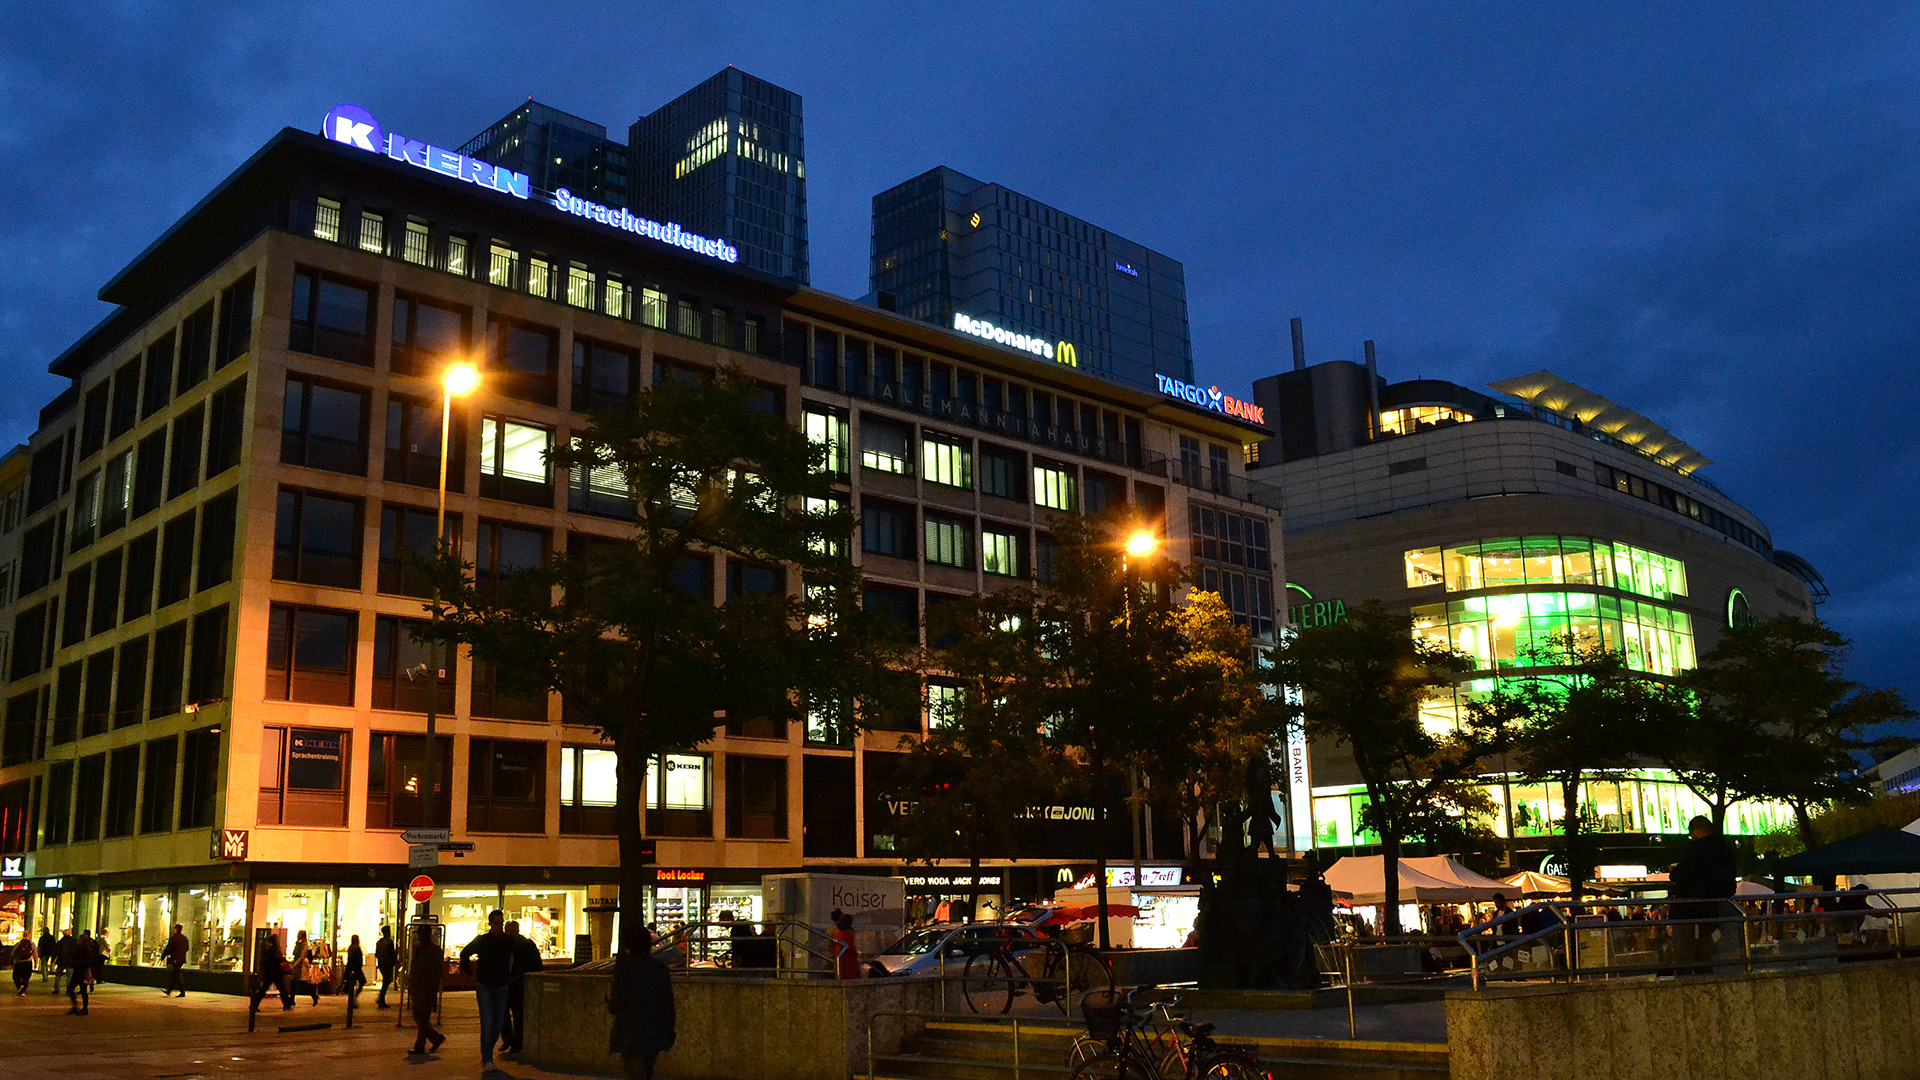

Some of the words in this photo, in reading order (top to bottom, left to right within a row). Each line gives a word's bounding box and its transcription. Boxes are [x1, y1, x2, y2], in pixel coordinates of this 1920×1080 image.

[388, 132, 530, 200] KERN
[555, 187, 738, 263] Sprachendienste
[953, 312, 1054, 359] McDonald's
[291, 752, 339, 762] Sprachentraining
[1292, 748, 1303, 784] BANK
[656, 869, 676, 880] Foot
[677, 869, 705, 880] Locker
[904, 877, 925, 885] VERO
[953, 877, 972, 885] JACK
[979, 877, 1001, 885] JONES
[832, 885, 887, 909] Kaiser
